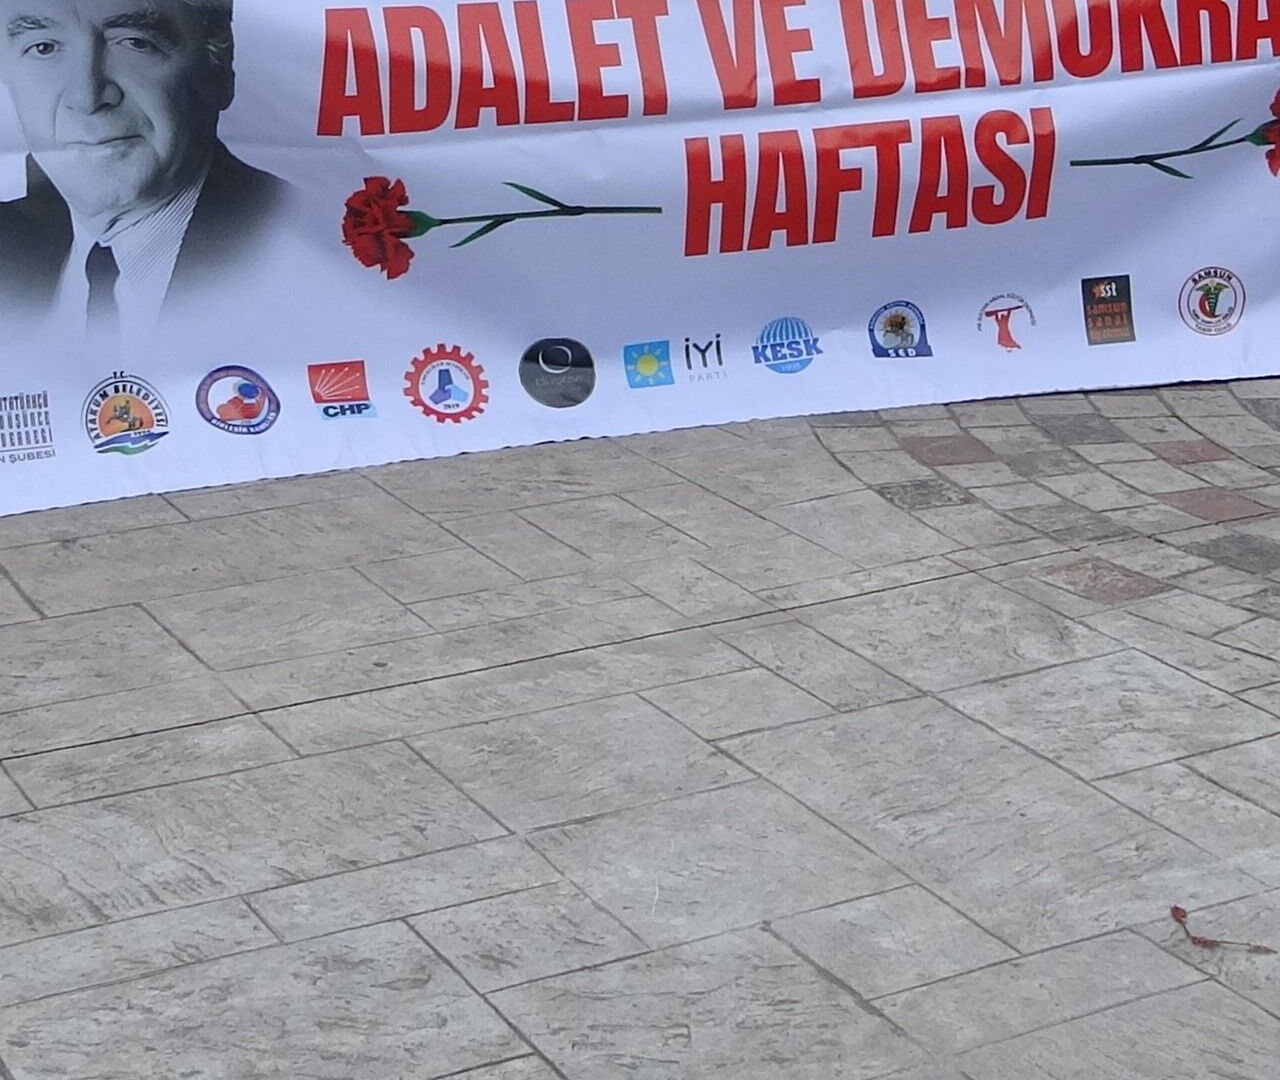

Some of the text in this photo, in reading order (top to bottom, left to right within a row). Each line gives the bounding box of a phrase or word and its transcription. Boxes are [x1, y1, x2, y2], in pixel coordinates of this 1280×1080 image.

[684, 107, 1056, 257] HAFTASI
[1191, 269, 1233, 285] SAMSUN
[752, 336, 823, 363] KESK
[89, 384, 168, 440] ATAKUM BELEDİYESİ
[322, 404, 371, 418] CHP
[9, 448, 56, 464] ŞUBESİ
